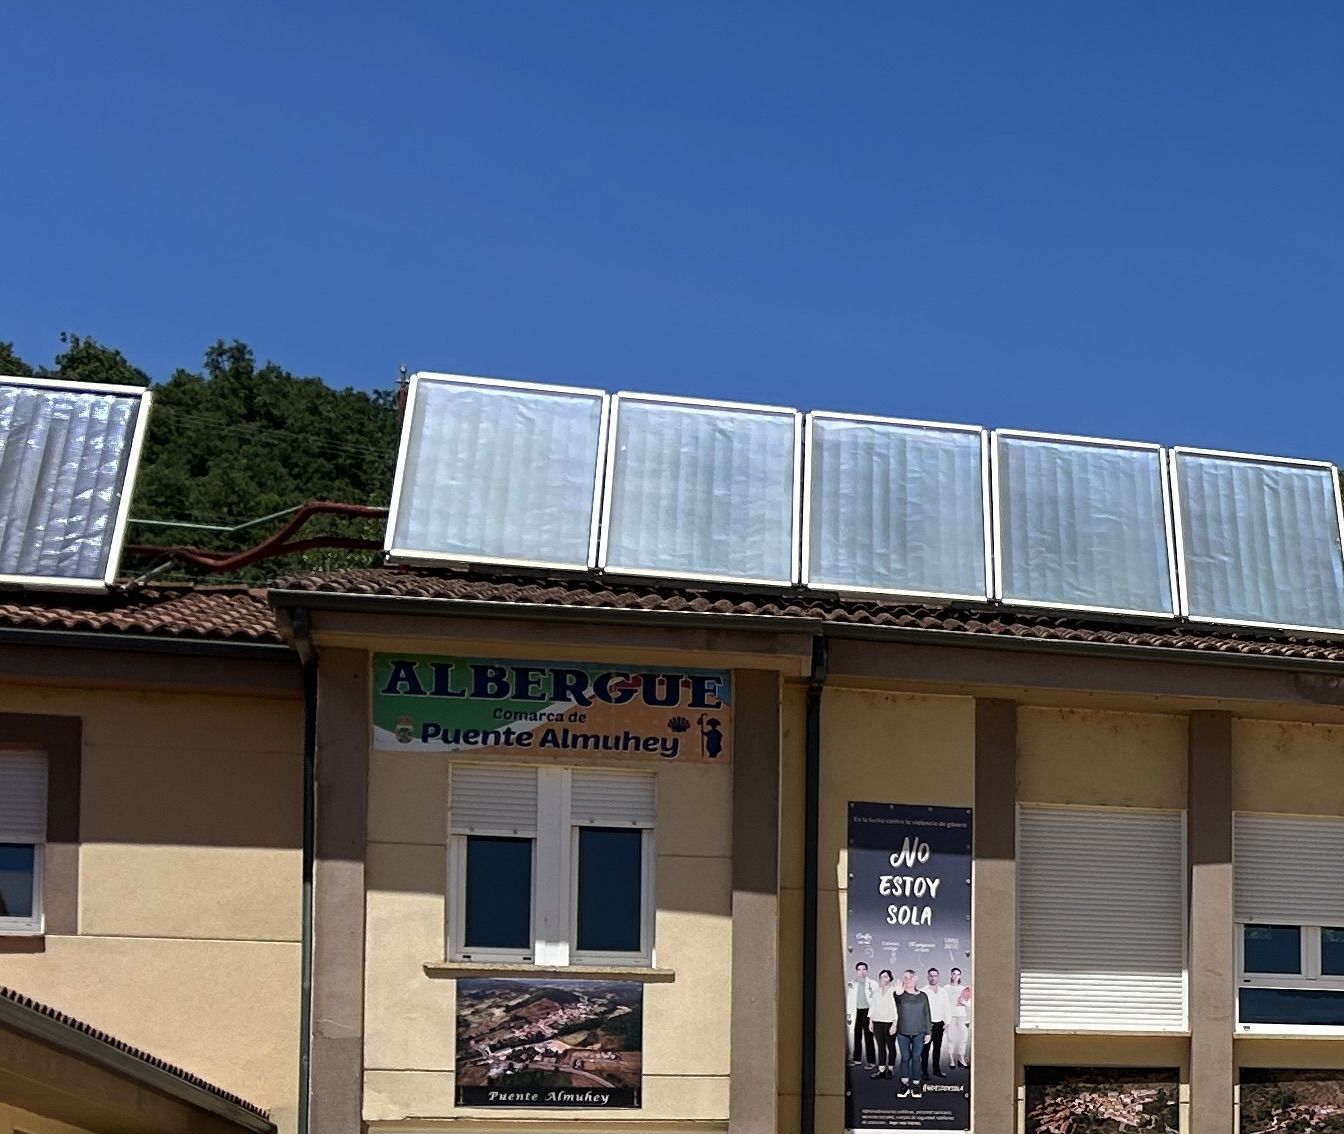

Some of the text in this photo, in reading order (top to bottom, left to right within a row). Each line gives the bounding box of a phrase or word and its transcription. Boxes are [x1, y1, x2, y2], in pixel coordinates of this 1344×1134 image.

[381, 660, 724, 710] ALBERGUE
[492, 707, 587, 724] Comarca de
[421, 722, 681, 758] Puente Almuhey
[879, 875, 940, 899] ESTOY
[887, 904, 932, 926] SOLA
[488, 1090, 610, 1105] Puente Almuhey
